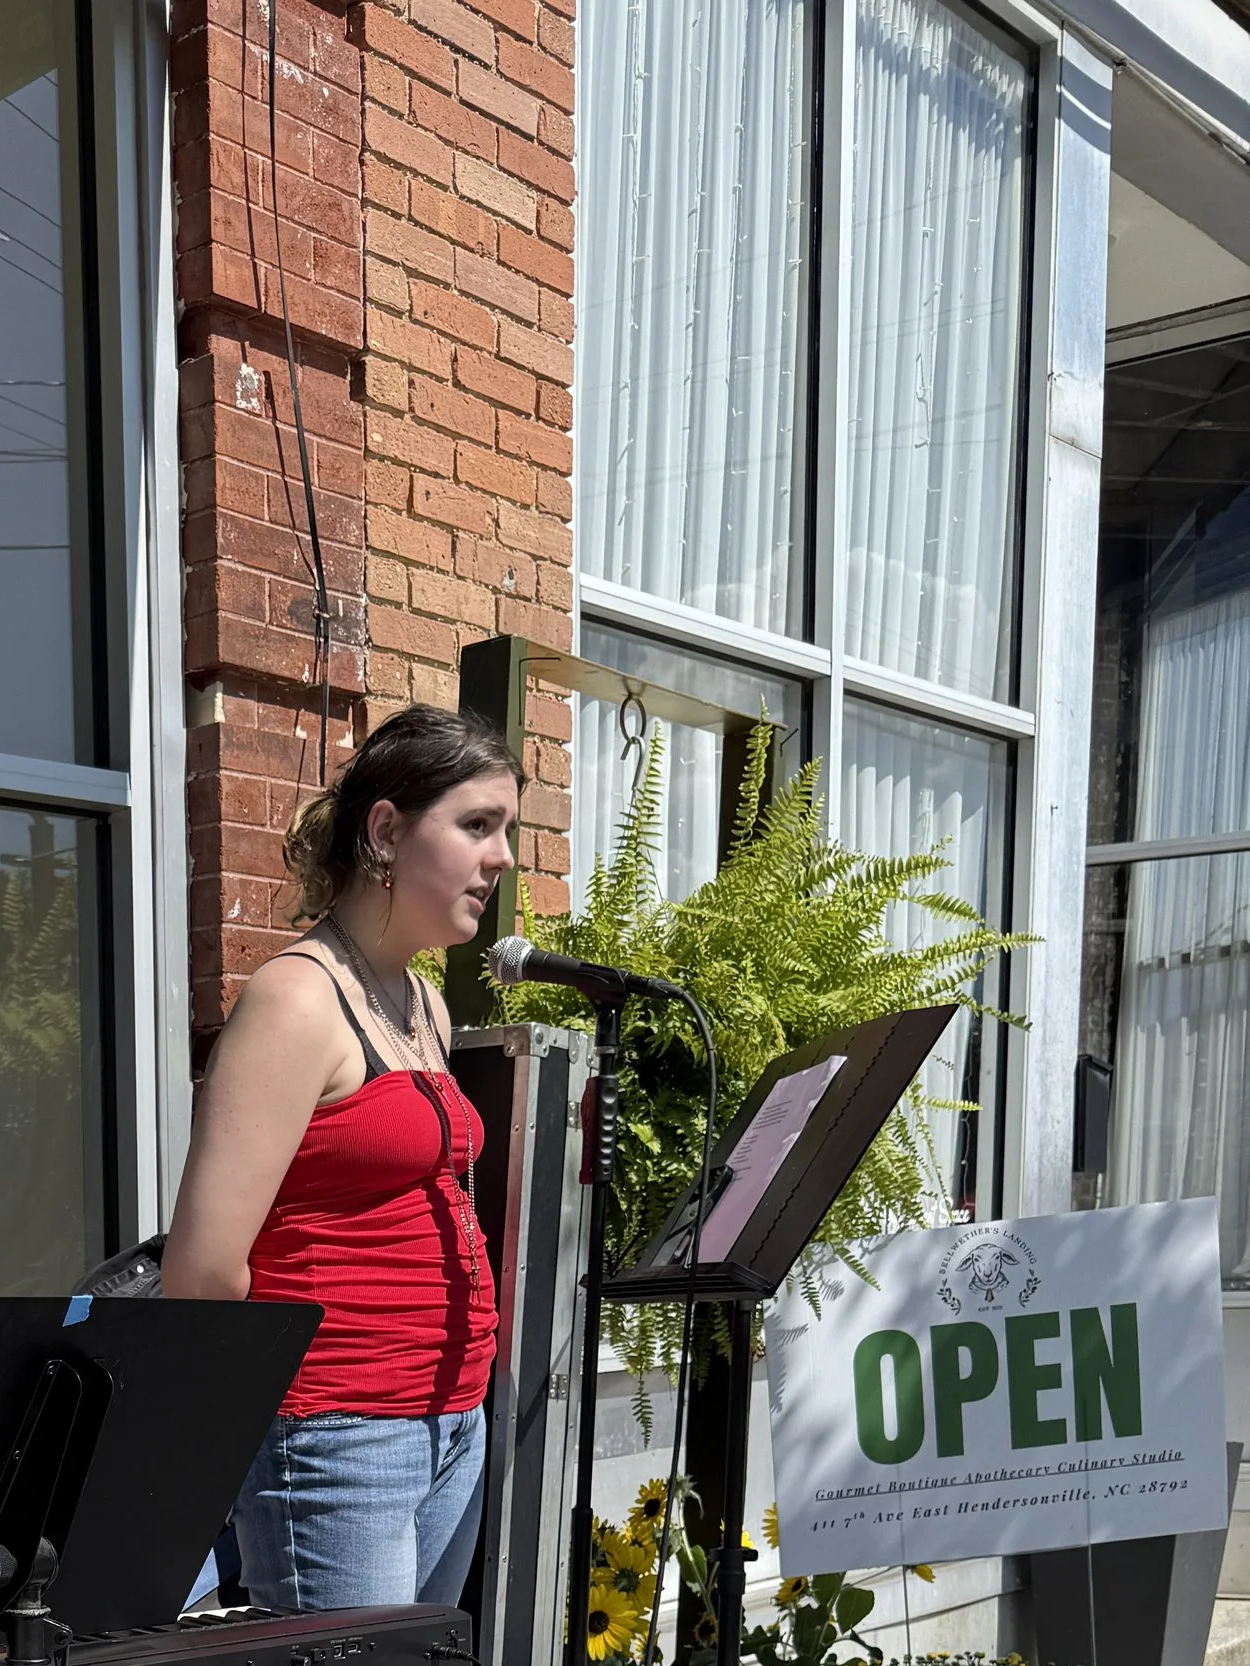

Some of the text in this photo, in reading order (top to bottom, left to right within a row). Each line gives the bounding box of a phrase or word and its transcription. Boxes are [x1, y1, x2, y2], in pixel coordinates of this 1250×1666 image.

[938, 1226, 1037, 1275] BELLWETHER'S LANDING
[852, 1302, 1143, 1465] OPEN
[815, 1449, 1183, 1501] Gourmet Boutique Apothecary Culinary Studio
[843, 1511, 865, 1529] 7th
[873, 1510, 905, 1524] Ave
[912, 1503, 949, 1520] East
[1104, 1483, 1131, 1499] NC
[1138, 1479, 1188, 1495] 28792
